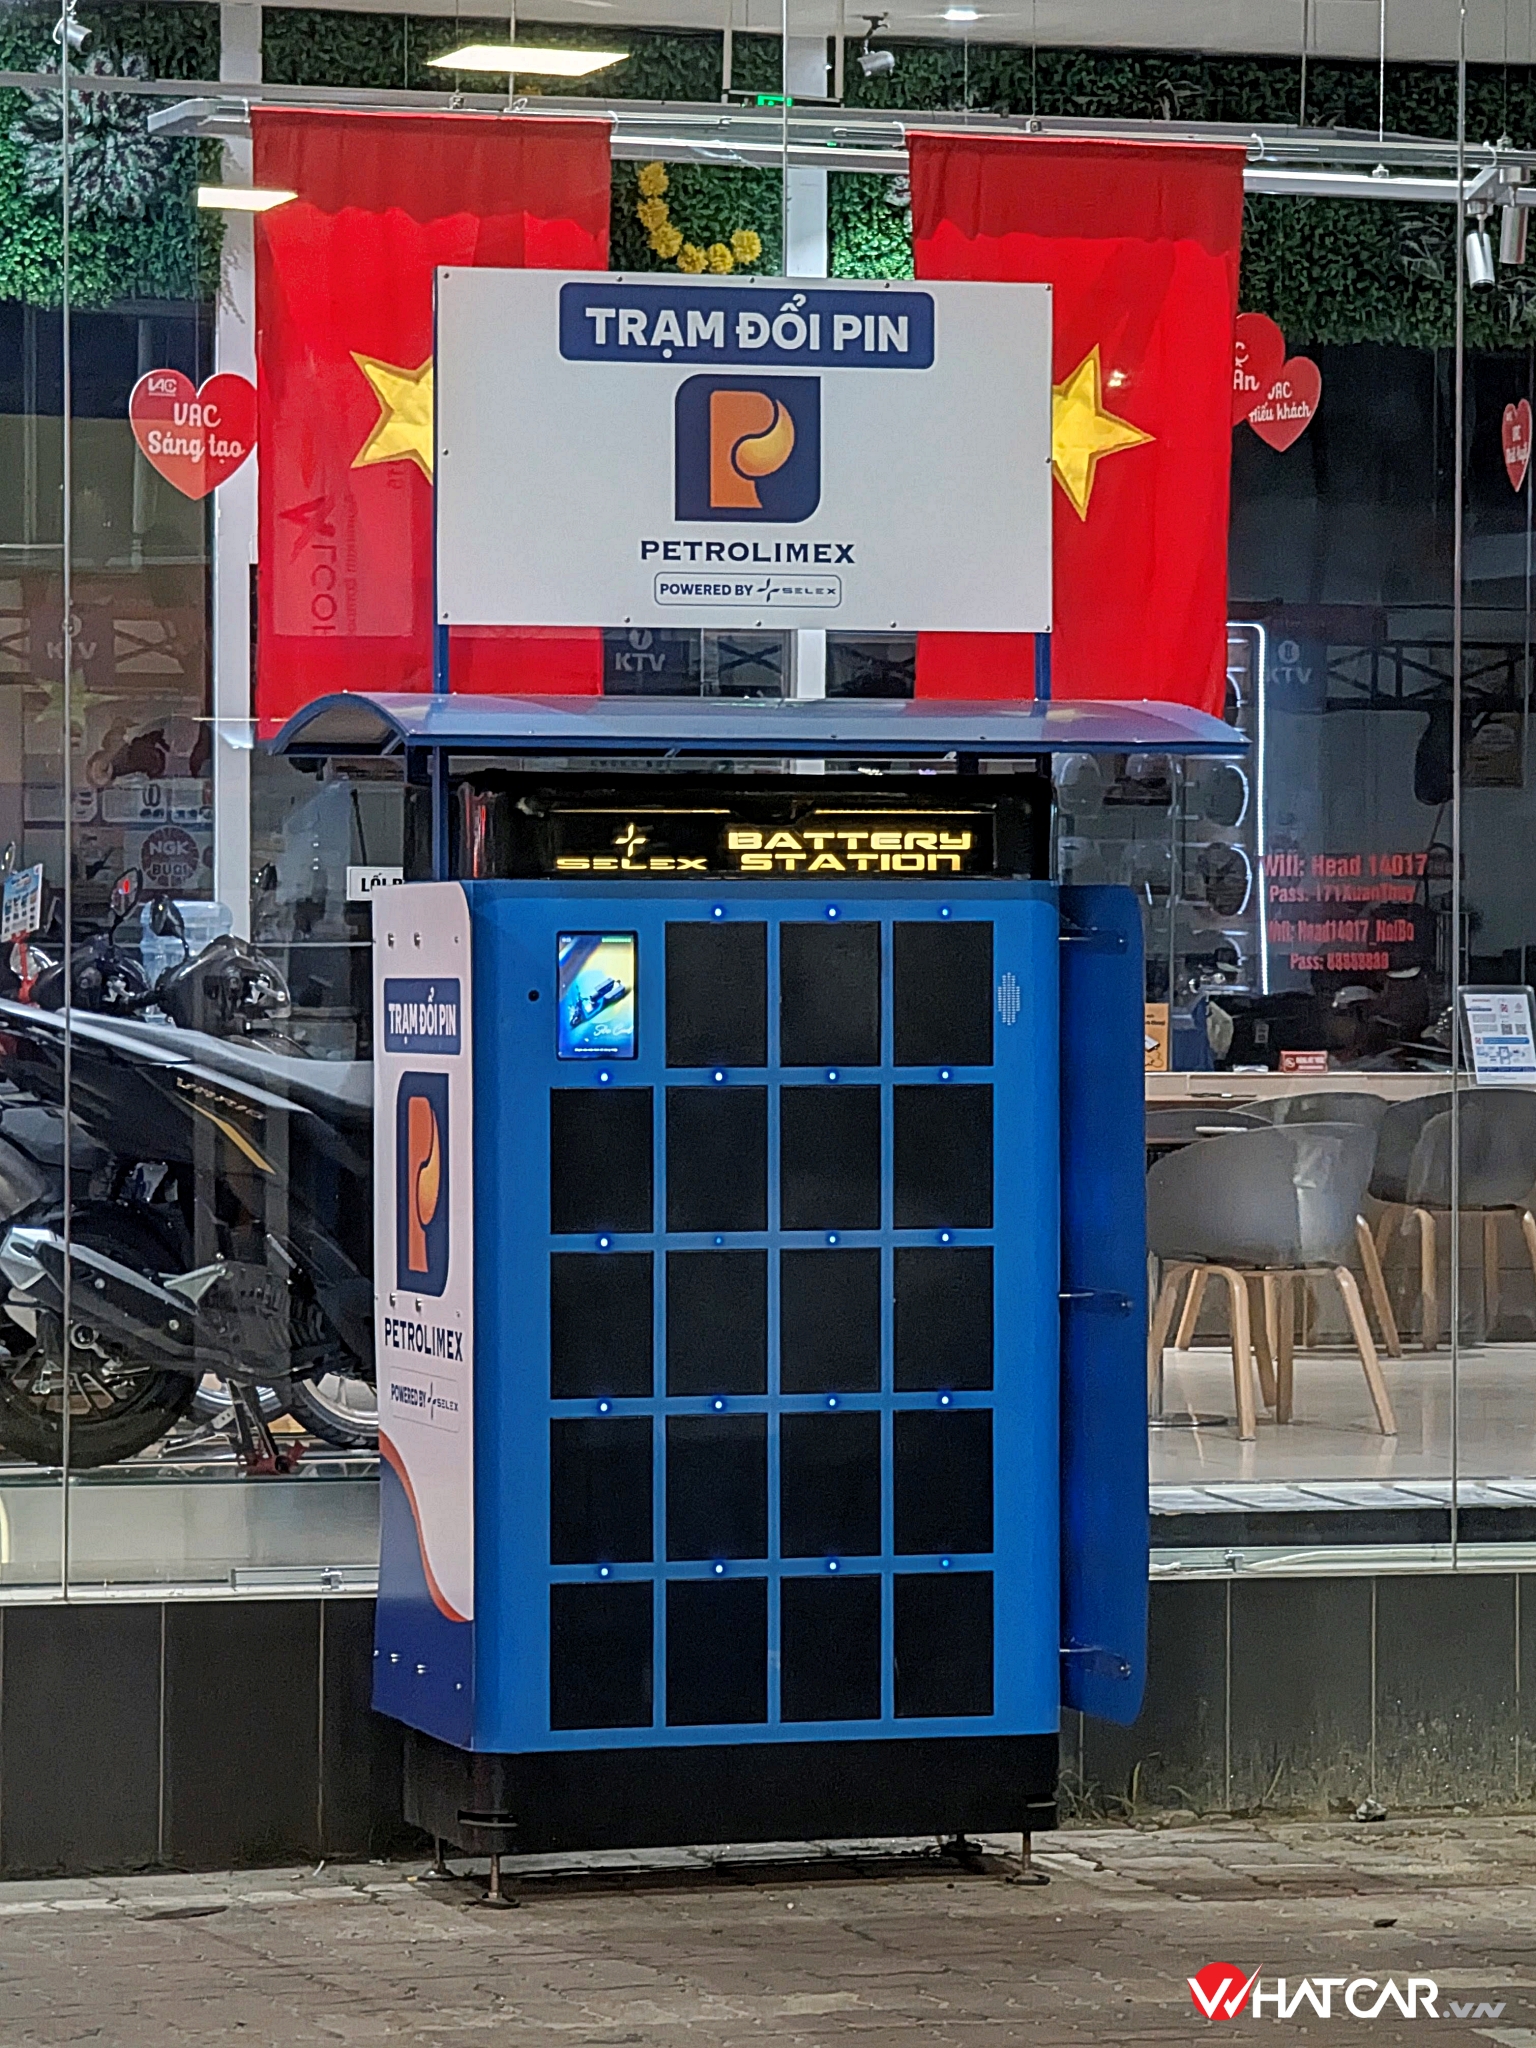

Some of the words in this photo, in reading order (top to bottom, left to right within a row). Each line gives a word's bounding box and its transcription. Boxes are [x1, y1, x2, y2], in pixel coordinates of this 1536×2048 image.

[585, 307, 724, 359] TRẠM
[735, 293, 820, 350] ĐỔI
[833, 314, 908, 353] PIN
[1276, 400, 1311, 420] khách
[148, 430, 205, 463] Sáng
[208, 433, 245, 464] tạo
[641, 540, 855, 564] PETROLIMEX
[660, 583, 732, 596] POWERED
[734, 583, 753, 596] BY
[782, 587, 836, 595] SELEX
[46, 641, 97, 660] KV
[615, 652, 665, 672] KTV
[150, 840, 189, 856] NGK
[727, 832, 972, 850] BATTERY
[556, 856, 708, 870] SELEX
[740, 853, 961, 871] STATION
[1312, 853, 1361, 877] Head
[1369, 853, 1428, 877] 14017
[1290, 953, 1324, 970] Pass:
[388, 1003, 418, 1045] TRẠM
[419, 987, 437, 1035] ĐỔI
[439, 1004, 456, 1036] PIN
[385, 1317, 463, 1362] PETROLIMEX
[391, 1383, 418, 1406] POWERED
[419, 1390, 427, 1408] BY
[437, 1398, 459, 1412] SELEX
